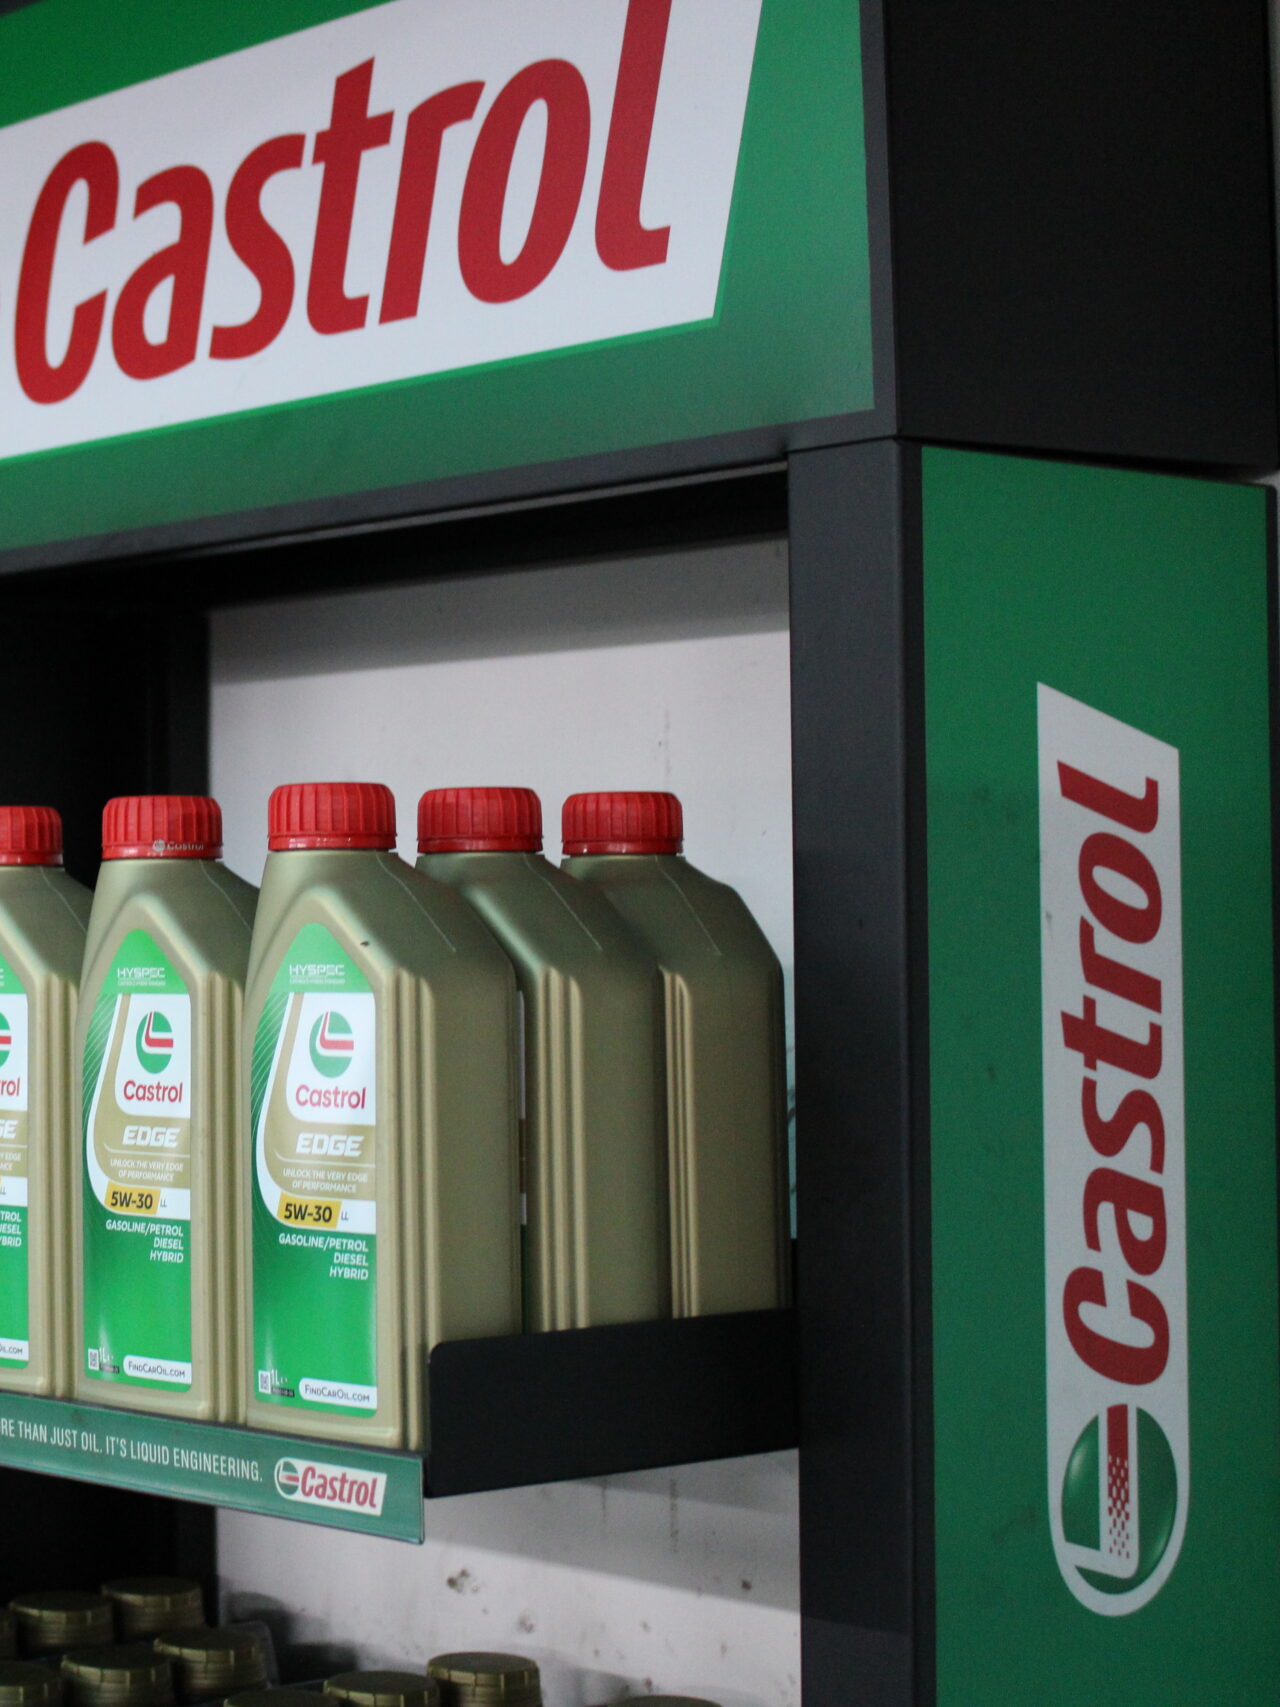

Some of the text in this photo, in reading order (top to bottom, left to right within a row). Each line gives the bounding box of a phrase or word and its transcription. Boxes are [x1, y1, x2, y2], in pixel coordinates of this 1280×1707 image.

[14, 0, 671, 404] Castrol
[117, 967, 166, 978] HYSPEC
[289, 964, 345, 976] HYSPEC
[1057, 760, 1171, 1387] Castrol
[123, 1079, 183, 1103] Castrol
[295, 1084, 367, 1109] Castrol
[122, 1125, 181, 1147] EDGE
[295, 1132, 365, 1157] EDGE
[110, 1159, 184, 1171] UNLOCK THE VERY EDGE
[118, 1169, 174, 1182] OF PERFORMANCE
[283, 1168, 369, 1183] UNLOCK THE VERY EDGE
[292, 1180, 357, 1193] OF PERFORMANCE
[110, 1191, 167, 1210] 5W-30 LL
[284, 1203, 349, 1223] 5W-30 LL
[106, 1219, 184, 1237] GASOLINE/PETROL
[153, 1237, 184, 1250] DIESEL
[278, 1232, 369, 1253] GASOLINE/PETROL
[150, 1250, 184, 1263] HYBRID
[333, 1252, 369, 1267] DIESEL
[329, 1266, 369, 1280] HYBRID
[18, 1420, 48, 1443] THAN
[50, 1426, 78, 1449] JUST
[81, 1431, 103, 1454] OIL.
[106, 1435, 127, 1458] IT'S
[130, 1439, 170, 1465] LIQUID
[173, 1449, 263, 1482] ENGINEERING.
[300, 1465, 378, 1508] Castrol
